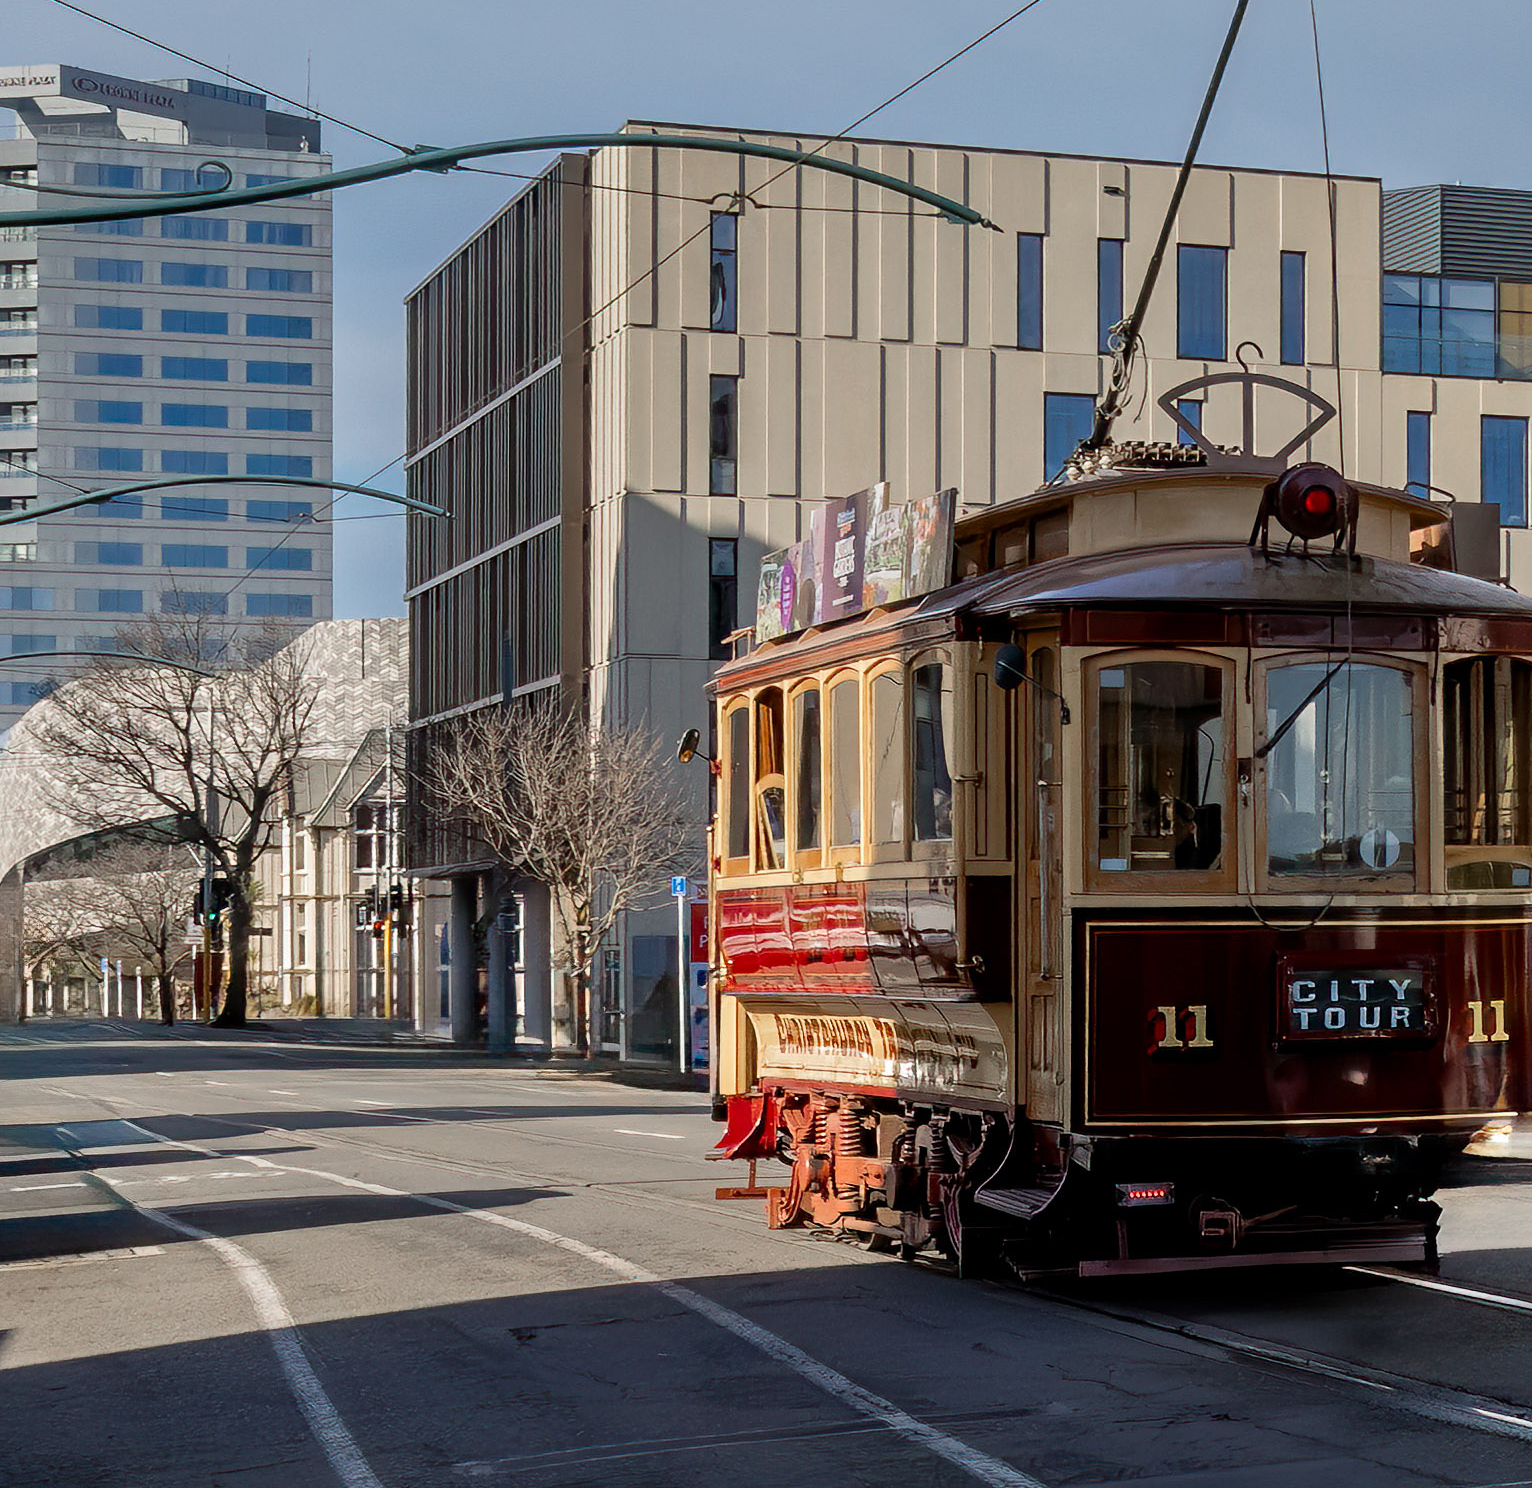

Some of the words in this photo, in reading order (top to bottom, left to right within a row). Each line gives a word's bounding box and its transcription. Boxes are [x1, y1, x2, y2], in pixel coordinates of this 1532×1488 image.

[1292, 979, 1413, 1003] CITY
[1157, 1005, 1214, 1047] 11
[1292, 1006, 1411, 1030] TOUR
[1467, 1000, 1509, 1043] 11
